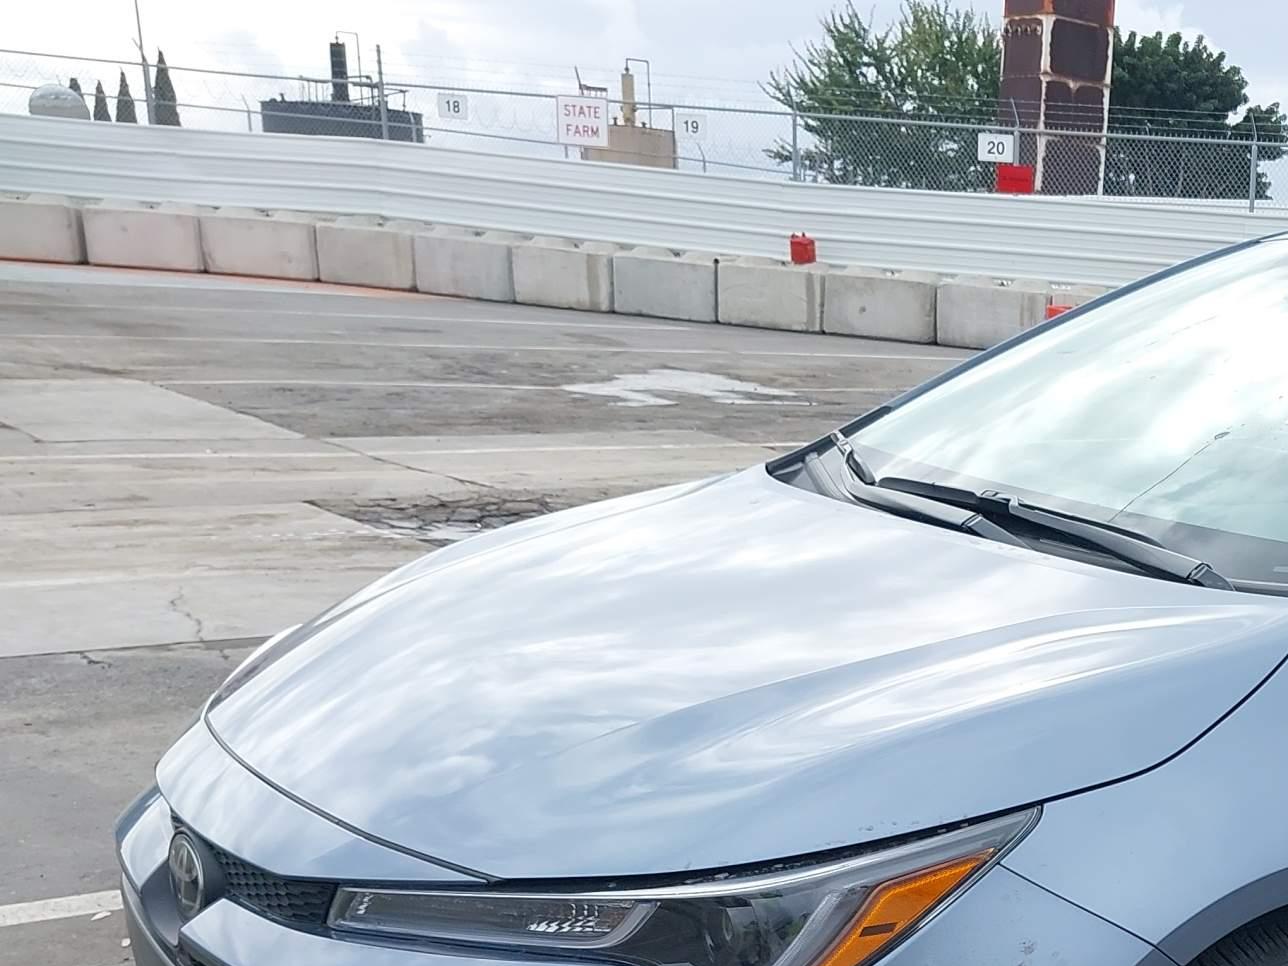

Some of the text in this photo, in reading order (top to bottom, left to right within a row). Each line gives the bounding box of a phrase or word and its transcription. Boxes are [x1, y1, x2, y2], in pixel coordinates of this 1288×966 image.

[445, 100, 460, 113] 18
[563, 104, 600, 119] STATE
[566, 123, 600, 138] FARM
[683, 120, 699, 133] 19
[987, 141, 1005, 155] 20
